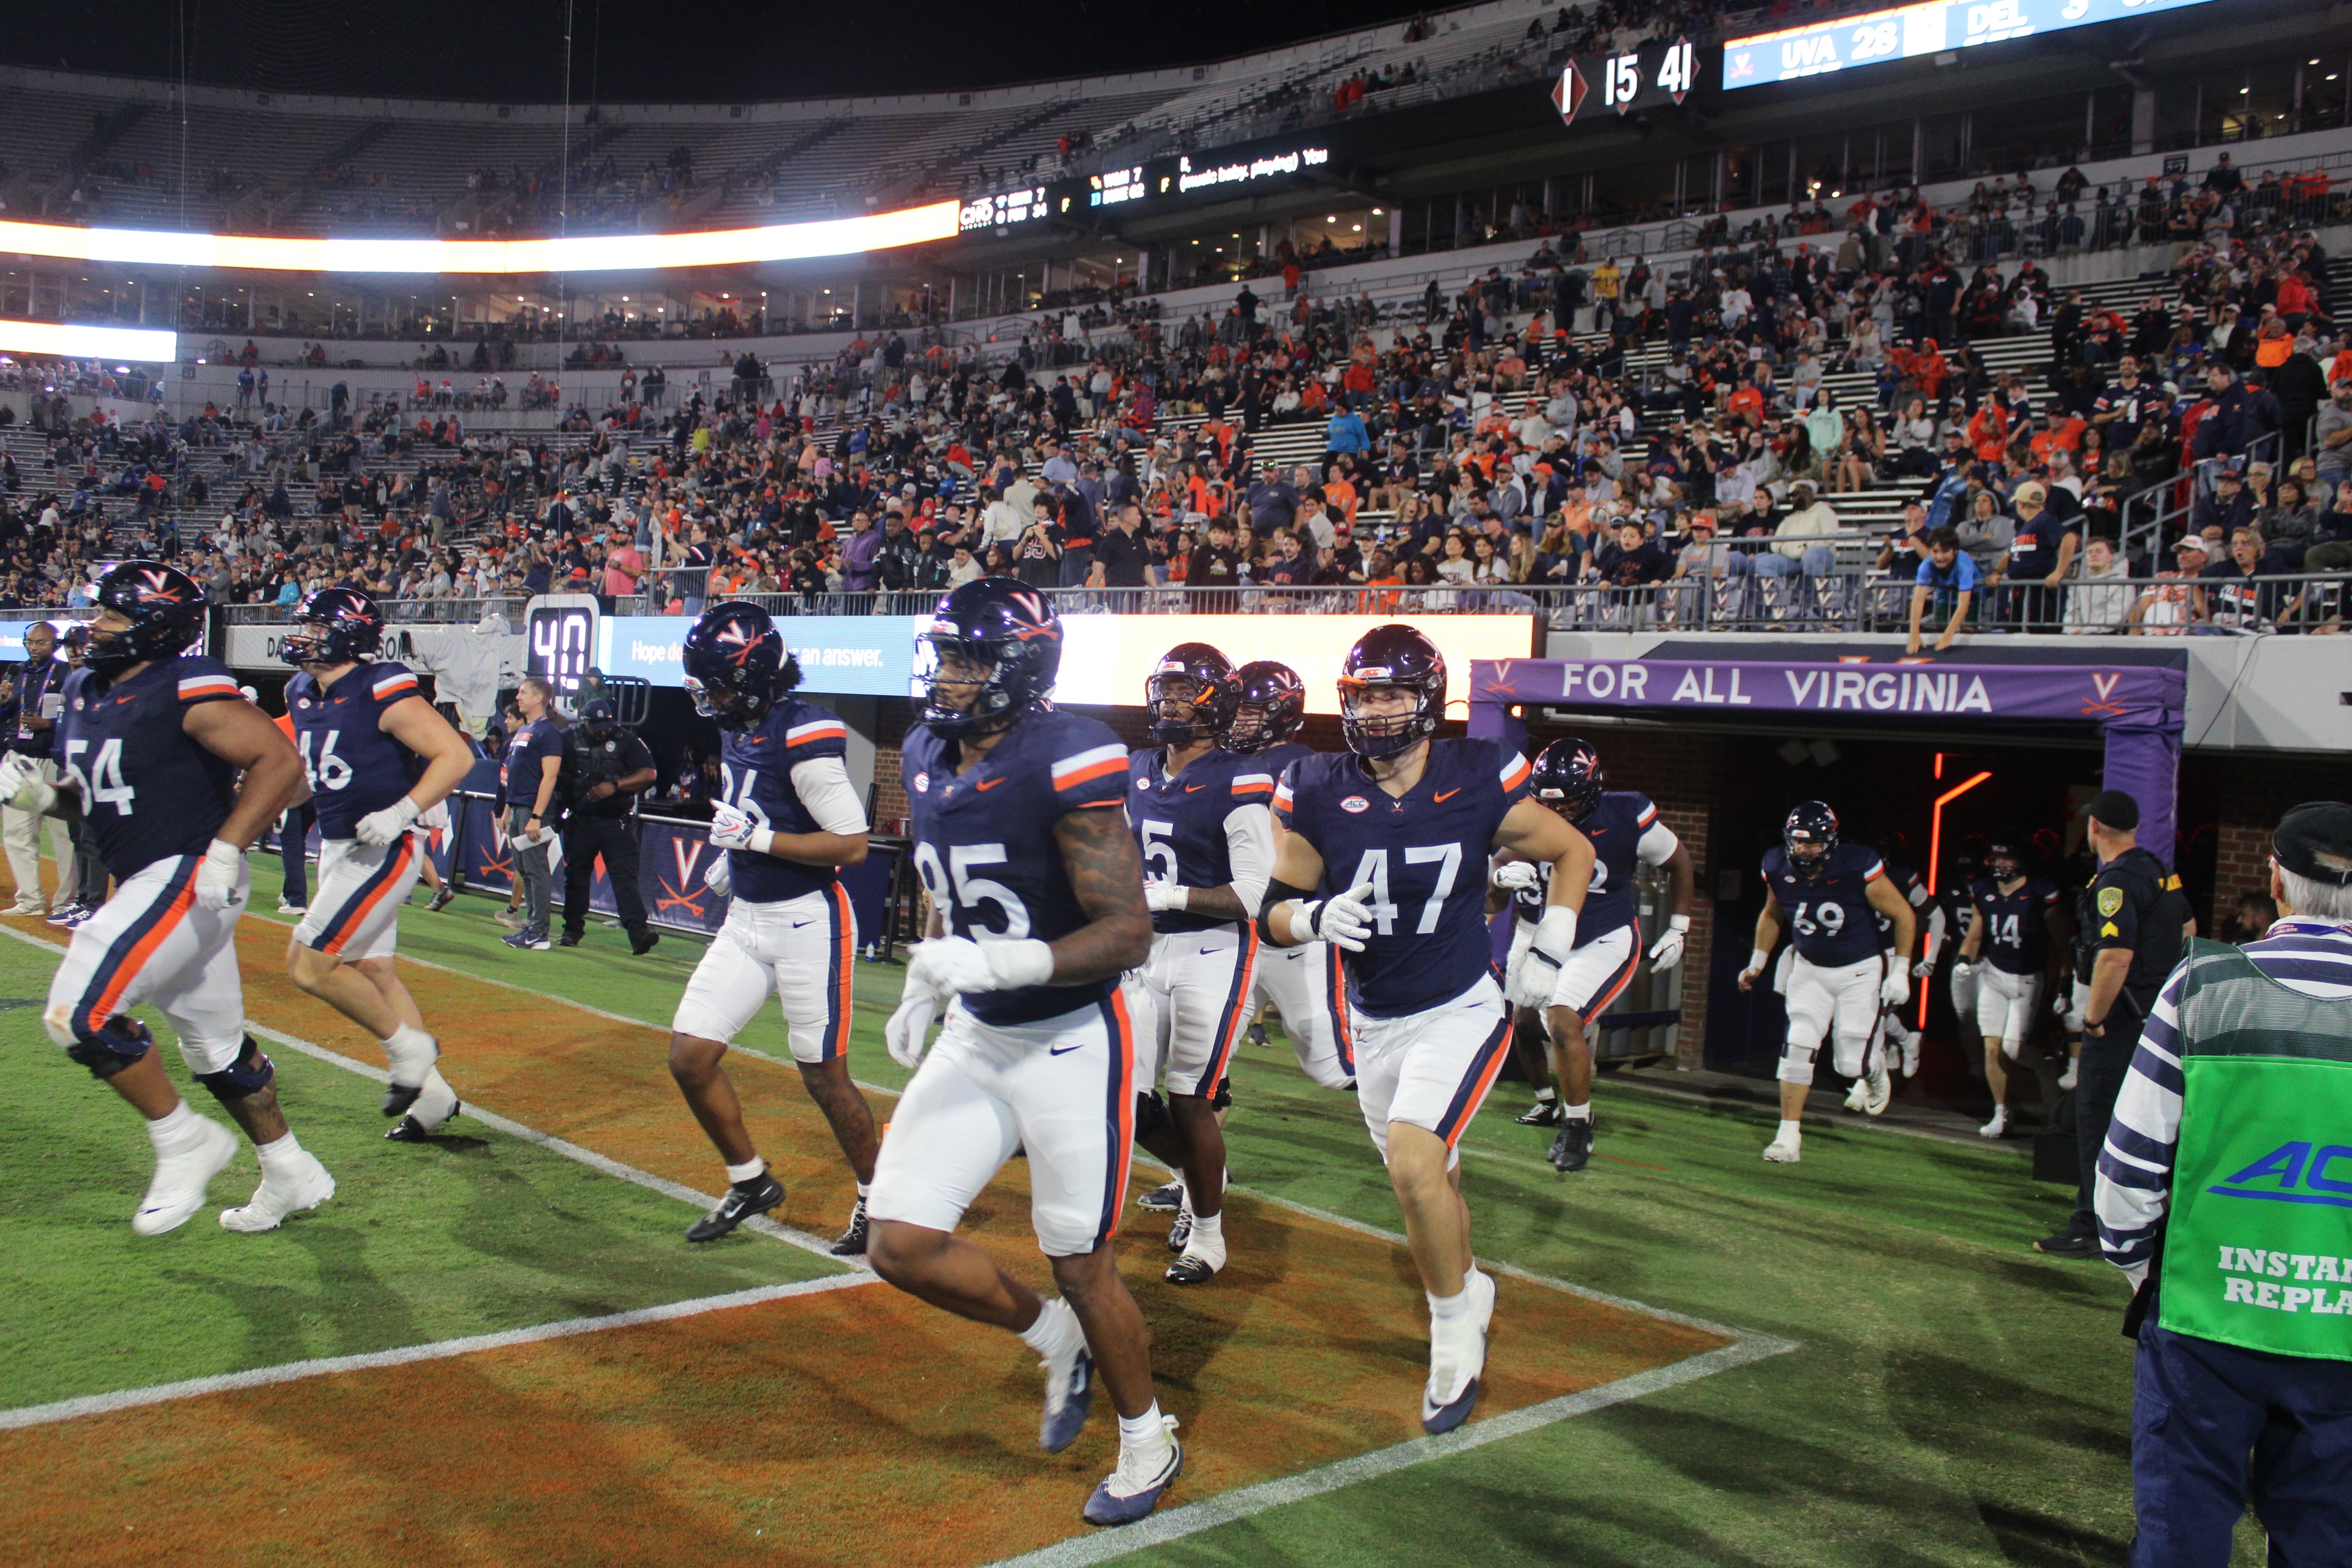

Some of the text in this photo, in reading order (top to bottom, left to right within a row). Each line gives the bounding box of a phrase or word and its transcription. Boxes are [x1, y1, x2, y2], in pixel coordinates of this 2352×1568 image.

[1782, 35, 1836, 69] UVA
[1851, 22, 1897, 60] 28
[1967, 0, 2028, 36] DEL
[1605, 54, 1638, 105] 15
[1657, 43, 1692, 92] 41
[1302, 148, 1328, 165] You
[960, 203, 993, 225] CHO
[535, 615, 587, 690] 40
[631, 641, 665, 665] Hope
[801, 648, 820, 666] an
[823, 648, 883, 667] answer.
[1563, 663, 1649, 700] FOR
[1673, 668, 1752, 704] ALL
[1785, 671, 1992, 714] VIRGINIA
[66, 738, 135, 816] 54
[1142, 818, 1178, 886] 5
[1349, 842, 1462, 935] 47
[1793, 902, 1845, 937] 69
[1991, 914, 2022, 949] 14
[2223, 1140, 2352, 1194] AC
[2224, 1276, 2352, 1316] REPLA
